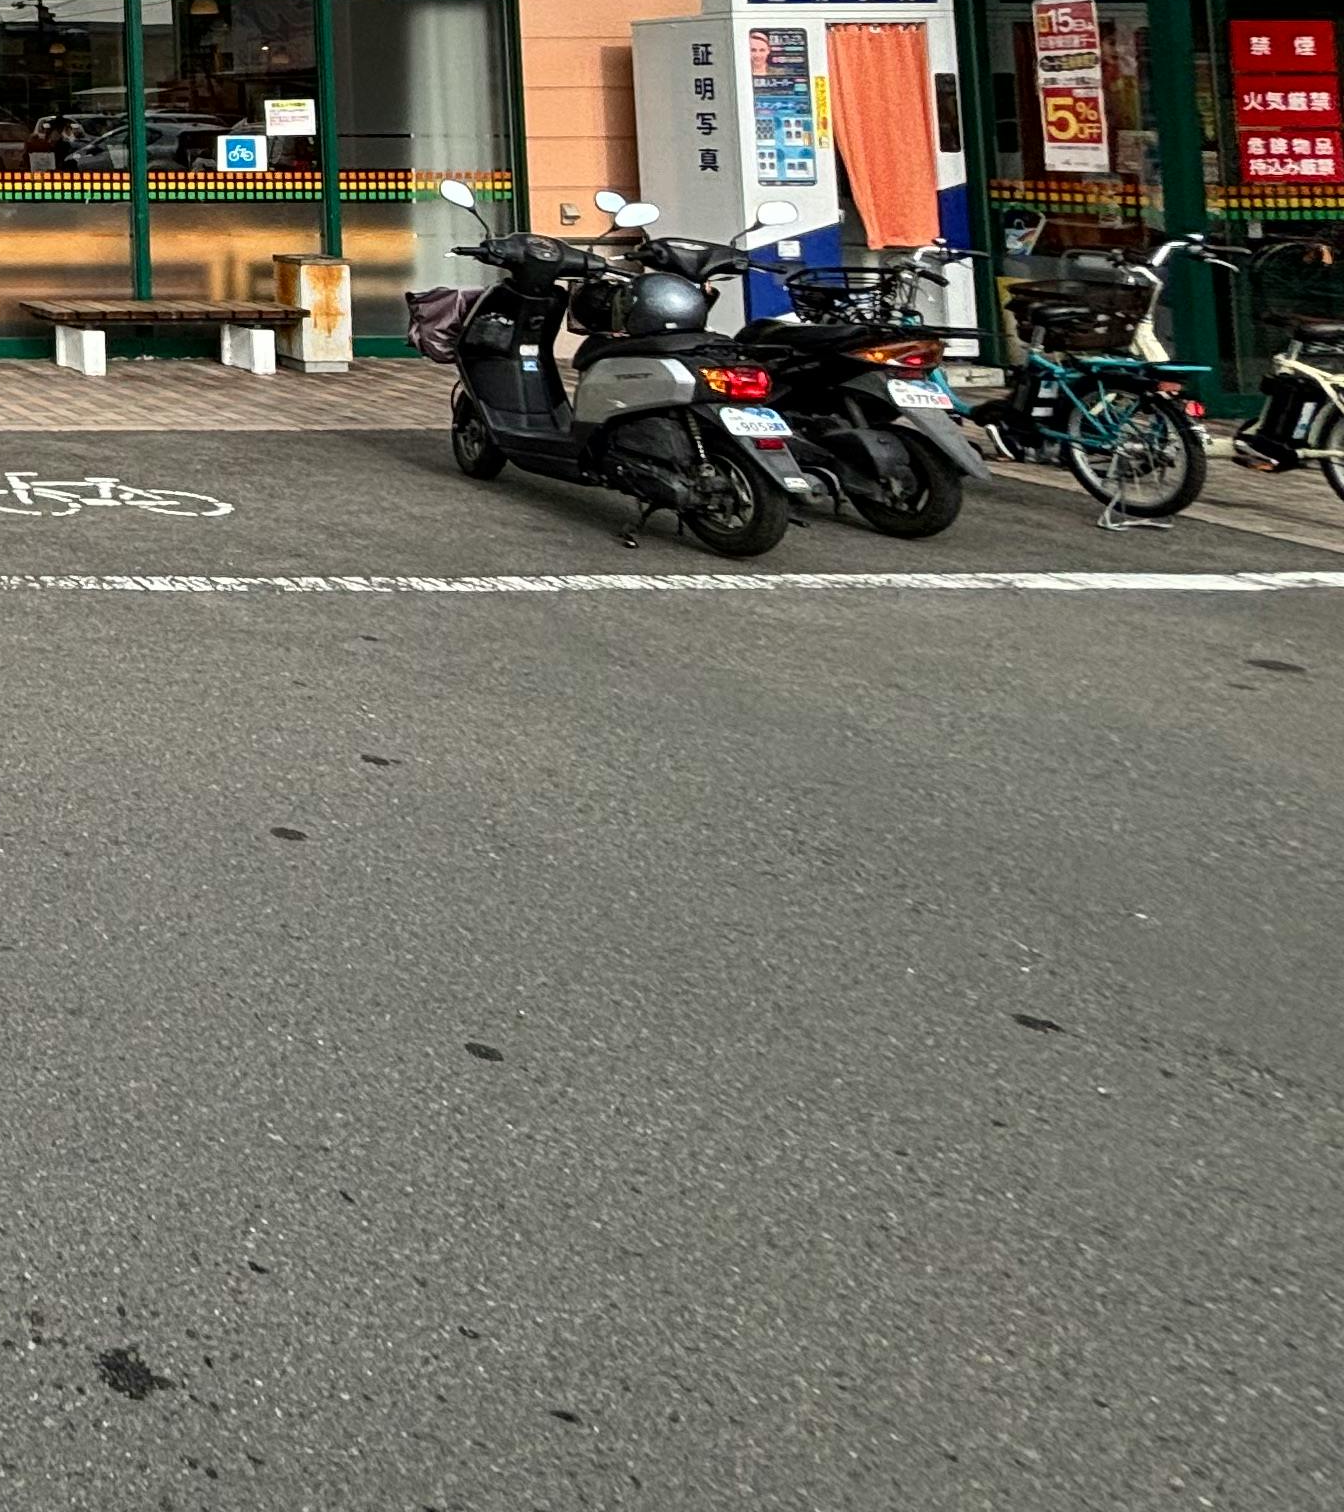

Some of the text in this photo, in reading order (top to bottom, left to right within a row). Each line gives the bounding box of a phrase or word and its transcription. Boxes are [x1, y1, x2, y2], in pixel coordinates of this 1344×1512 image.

[1249, 36, 1317, 56] 禁煙
[691, 43, 719, 173] 証明写真
[1242, 91, 1332, 112] 火気厳禁
[1247, 137, 1334, 155] 危険物品
